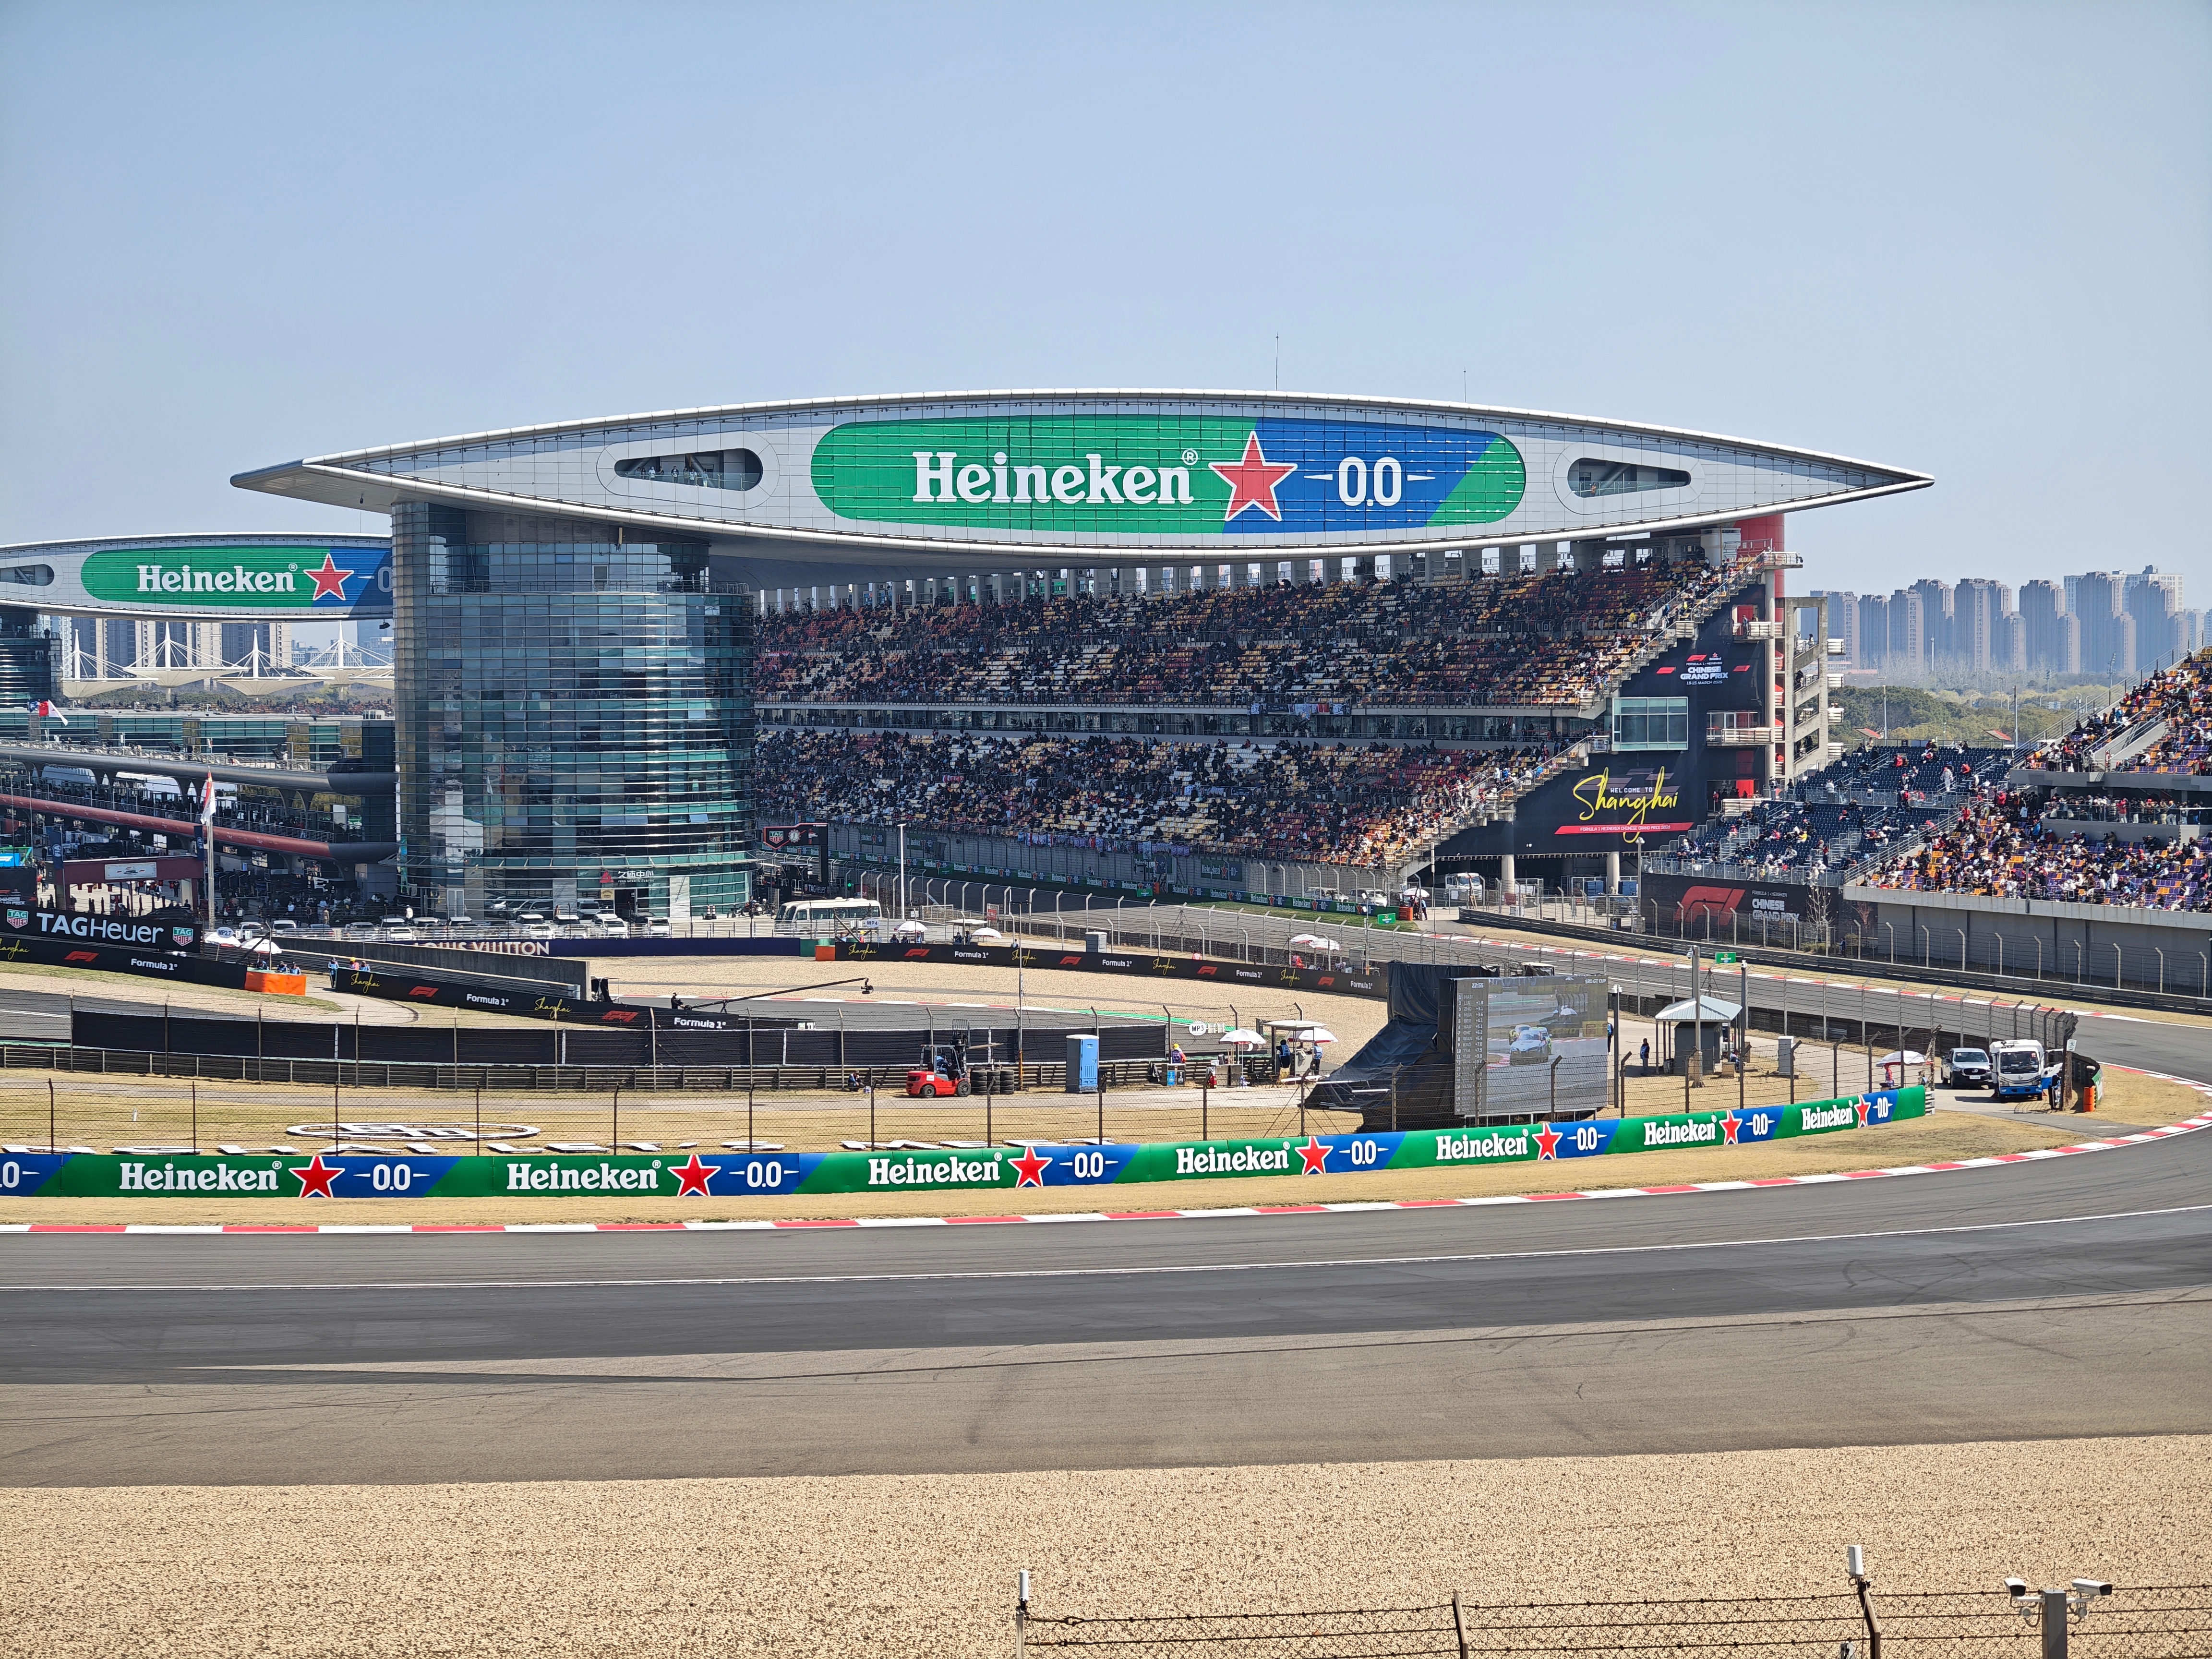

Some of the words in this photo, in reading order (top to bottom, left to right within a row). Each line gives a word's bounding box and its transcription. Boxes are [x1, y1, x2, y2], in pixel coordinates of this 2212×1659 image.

[1573, 766, 1678, 843] Shanghai
[1172, 885, 1189, 894] Heineken
[1210, 889, 1227, 899] Heineken
[1250, 893, 1268, 904] Heineken
[1292, 898, 1311, 908] Heineken
[1752, 898, 1785, 911] CHINESE
[1336, 902, 1356, 913] Heineken
[8, 917, 26, 927] HEUER
[174, 935, 192, 944] HEUER
[848, 943, 878, 960] Shanghai
[954, 950, 982, 959] Formula
[131, 958, 168, 970] Formula
[1153, 959, 1177, 975] Shanghai
[1236, 969, 1257, 977] Formula
[350, 972, 382, 994] Shanghai
[1350, 980, 1368, 989] Formula
[467, 993, 499, 1005] Formula
[534, 996, 572, 1019] Shanghai
[674, 1017, 714, 1029] Formula
[1753, 1113, 1768, 1136] 0.0
[1577, 1127, 1598, 1151] 0.0
[1351, 1140, 1376, 1166] 0.0
[1074, 1152, 1103, 1178] 0.0
[373, 1164, 410, 1191] 0.0
[746, 1162, 782, 1188] 0.0
